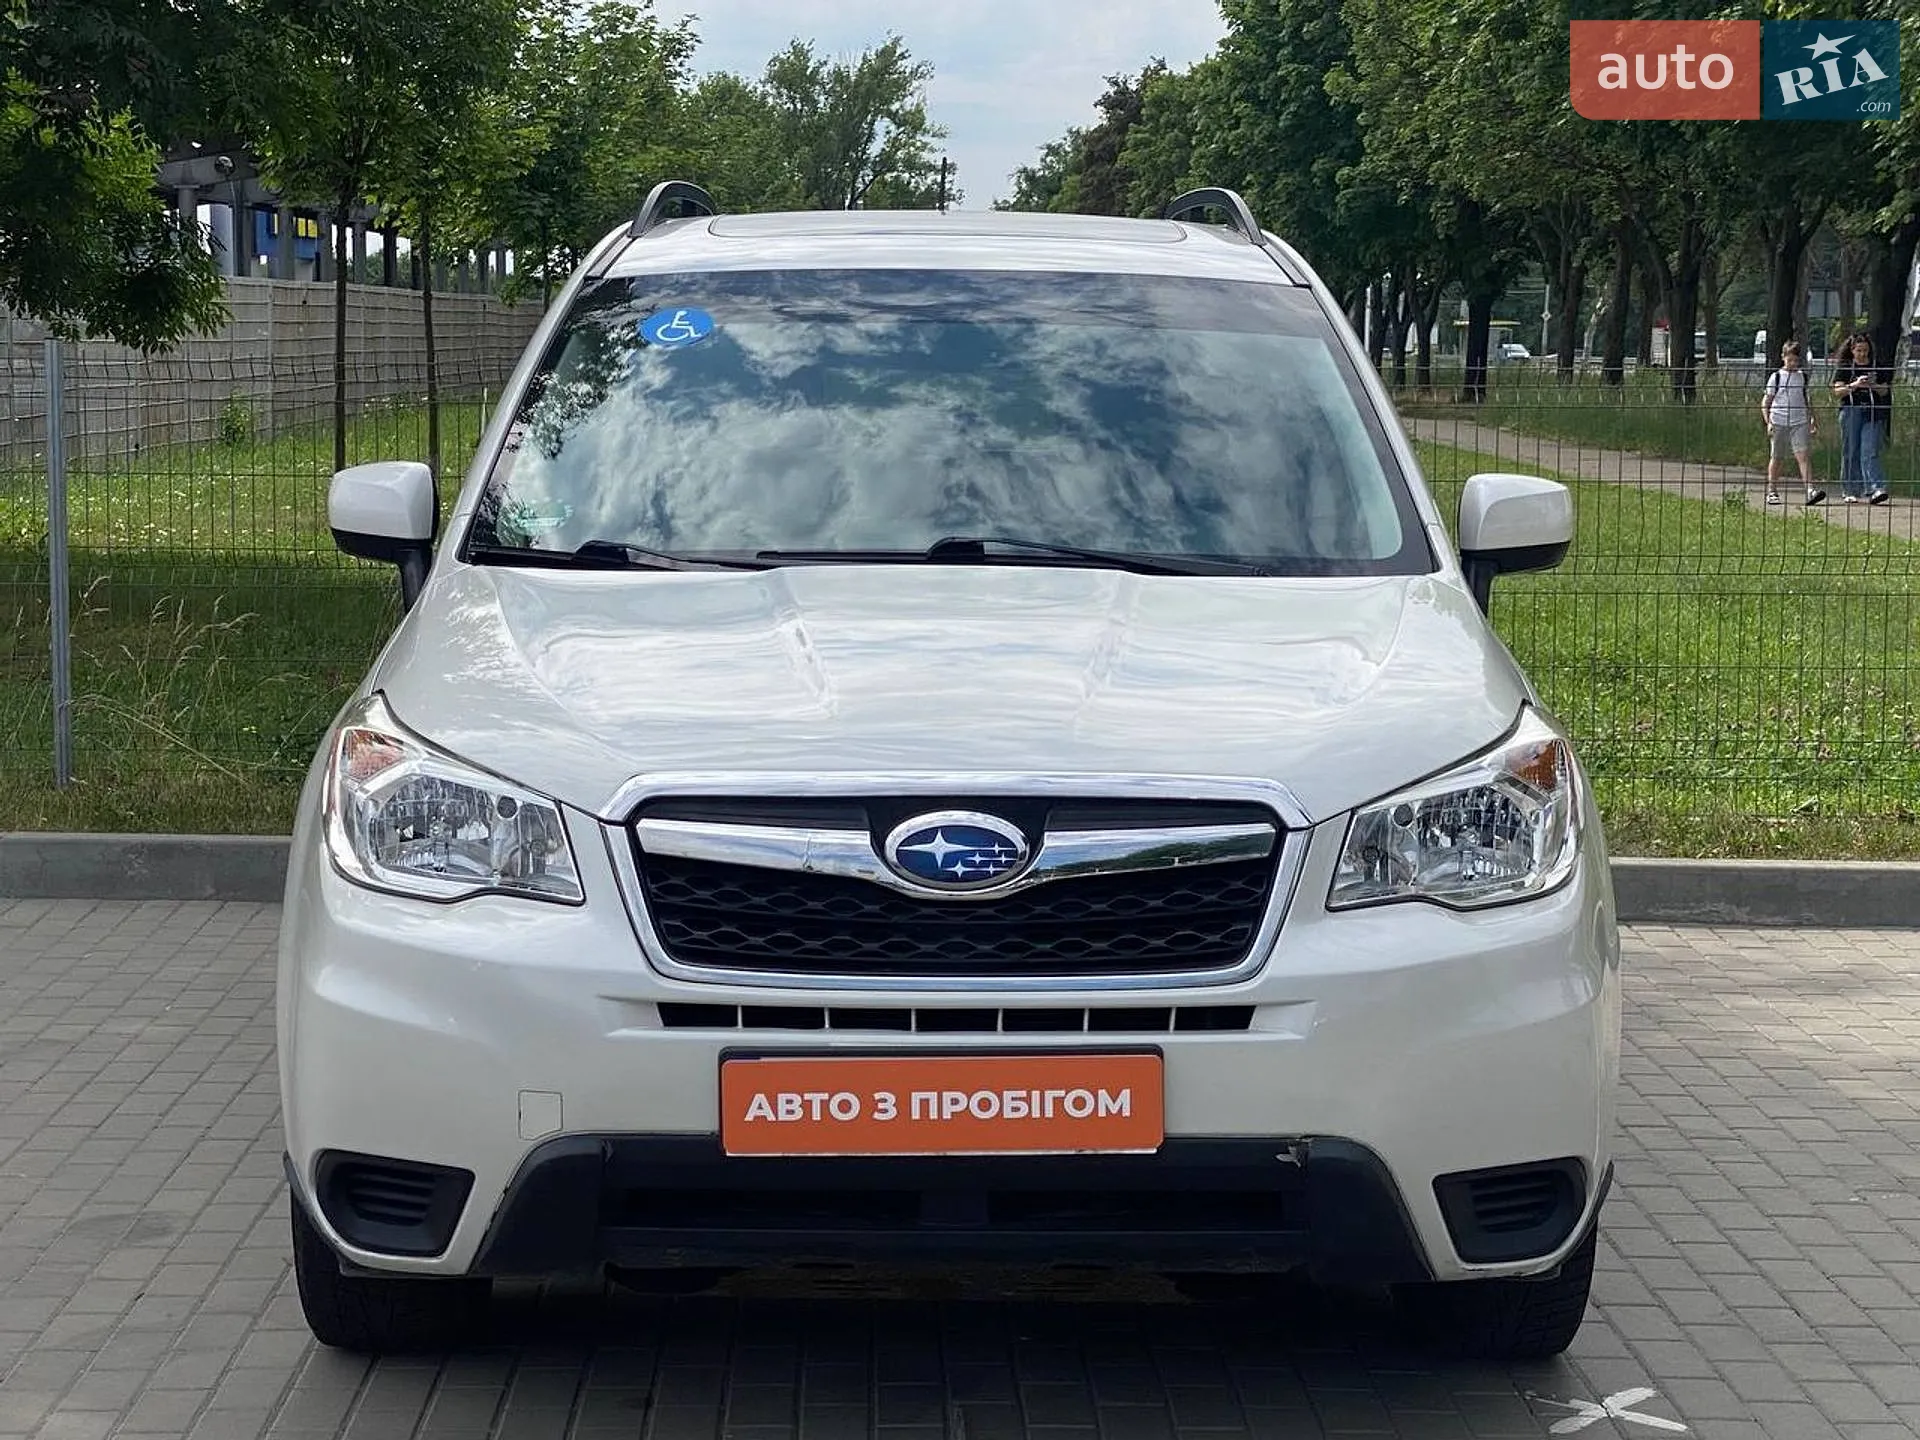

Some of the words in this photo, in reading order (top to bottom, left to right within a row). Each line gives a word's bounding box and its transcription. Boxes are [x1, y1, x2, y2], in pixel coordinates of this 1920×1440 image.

[744, 1092, 861, 1122] АВТО
[873, 1091, 897, 1121] З
[911, 1088, 1131, 1121] ПРОБІГОМ
